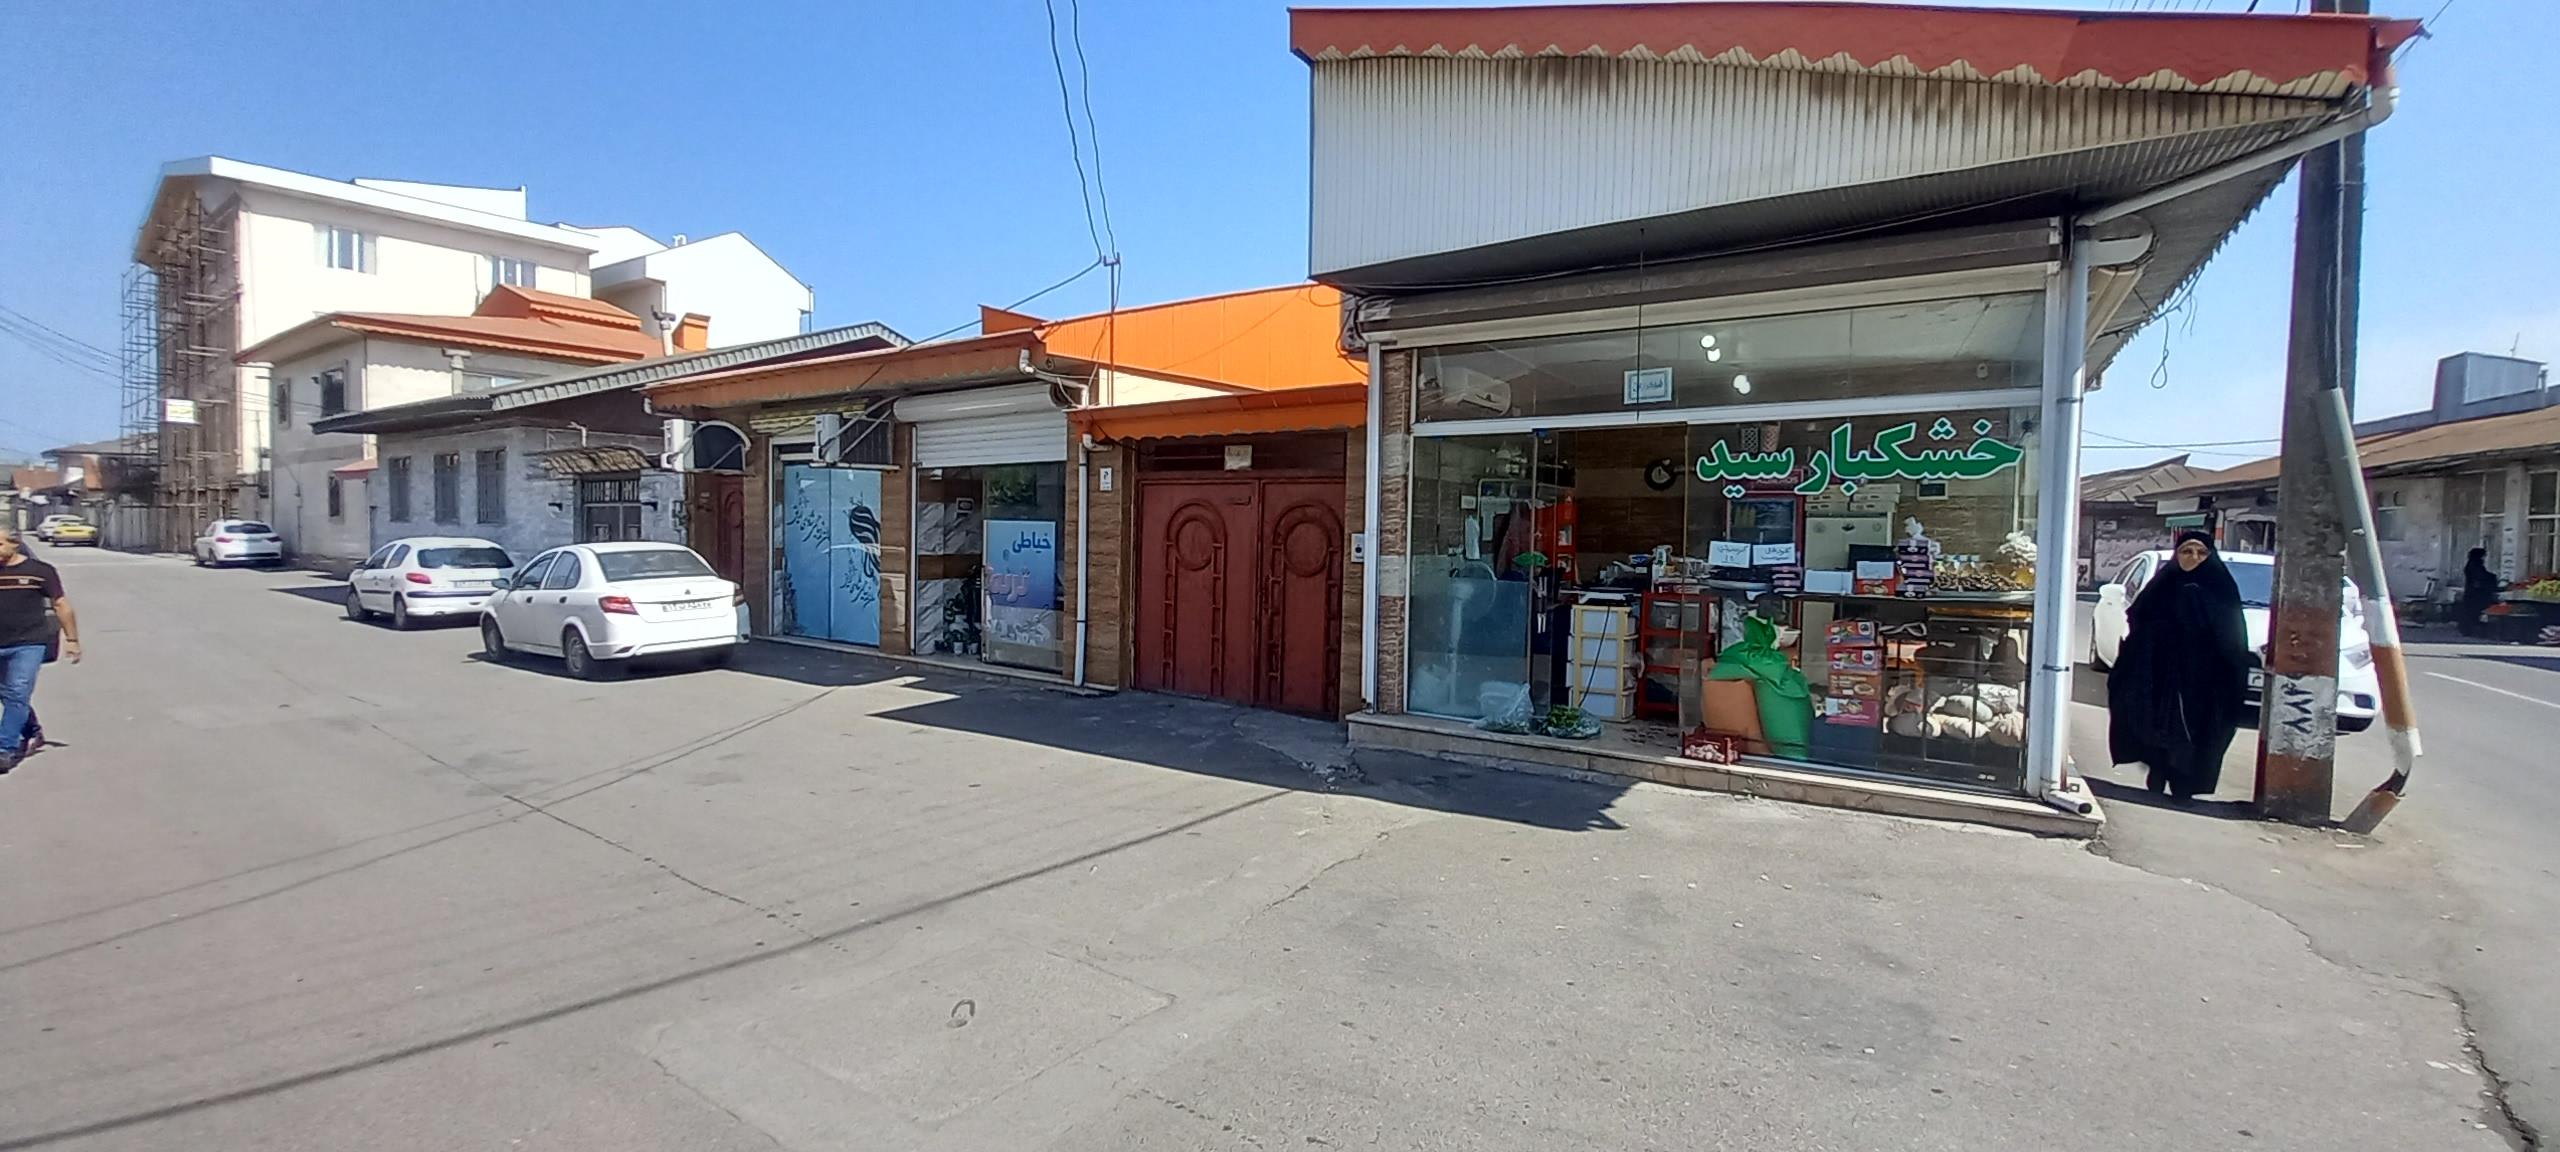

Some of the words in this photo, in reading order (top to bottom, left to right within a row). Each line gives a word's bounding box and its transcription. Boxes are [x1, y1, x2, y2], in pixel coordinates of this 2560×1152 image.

[1696, 438, 1795, 498] سید
[1796, 417, 2024, 497] خشکبار
[1012, 530, 1052, 554] خیاطی
